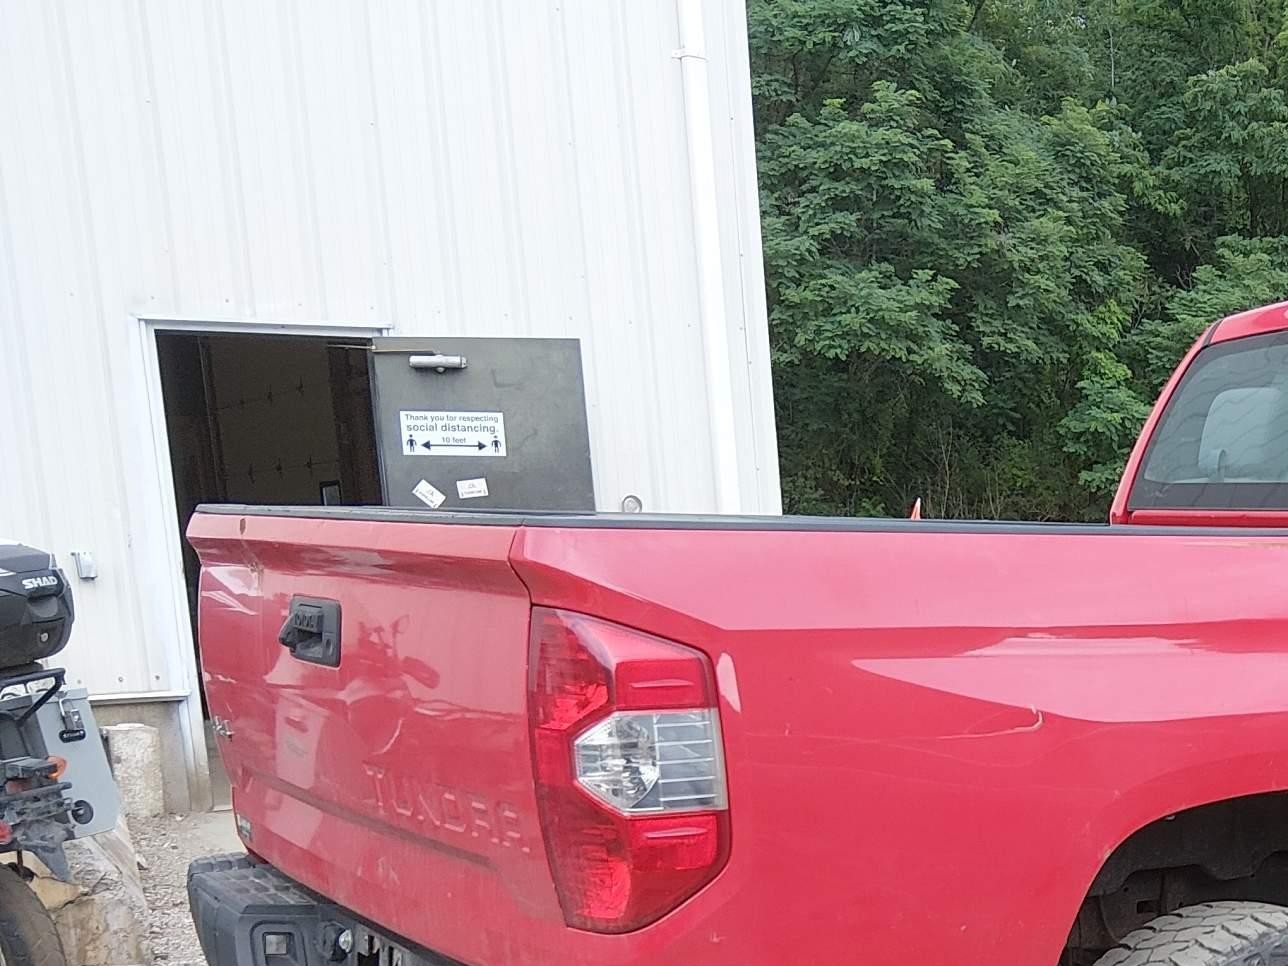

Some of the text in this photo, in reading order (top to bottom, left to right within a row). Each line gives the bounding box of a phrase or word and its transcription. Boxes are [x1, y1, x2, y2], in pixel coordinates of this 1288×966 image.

[405, 413, 499, 423] Thank you for respecting
[406, 423, 438, 432] social
[441, 436, 467, 444] 10 feet
[22, 575, 58, 590] SHAD
[362, 760, 531, 853] TUNDRA
